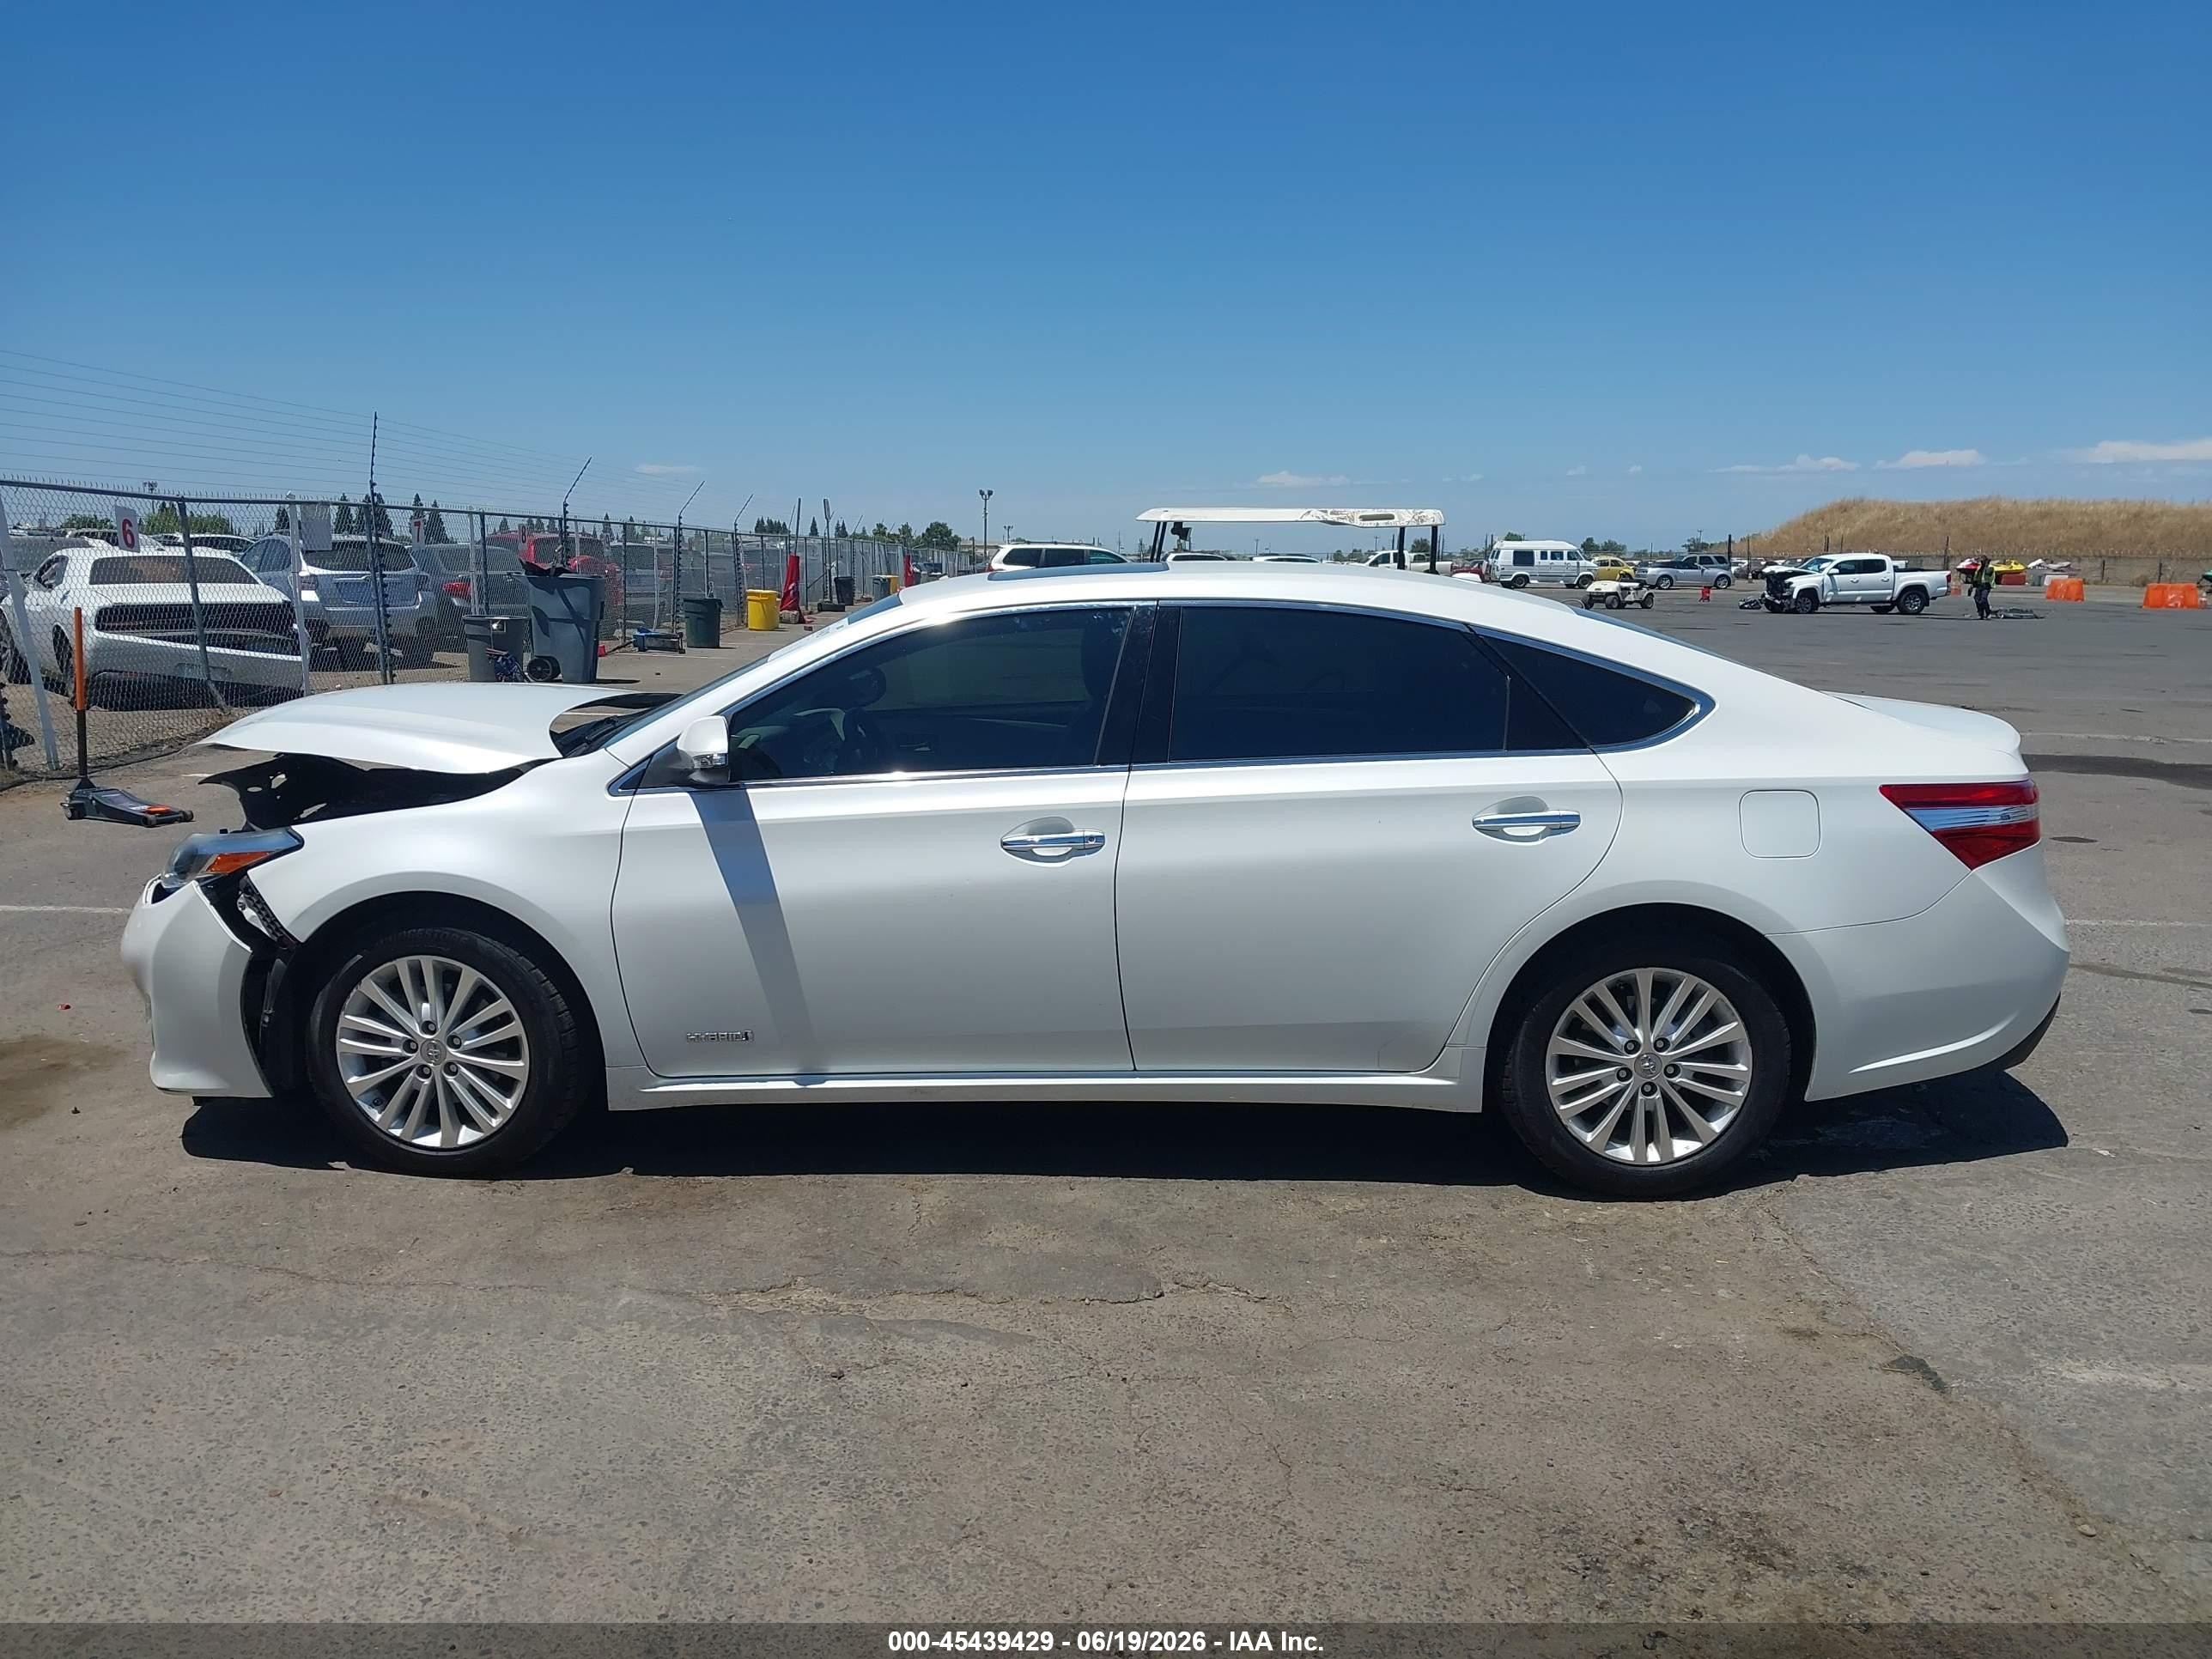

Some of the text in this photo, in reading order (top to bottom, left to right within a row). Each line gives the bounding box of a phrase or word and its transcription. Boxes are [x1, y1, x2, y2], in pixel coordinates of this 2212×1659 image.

[122, 518, 135, 550] 6
[413, 520, 422, 543] 7
[521, 525, 526, 544] 8
